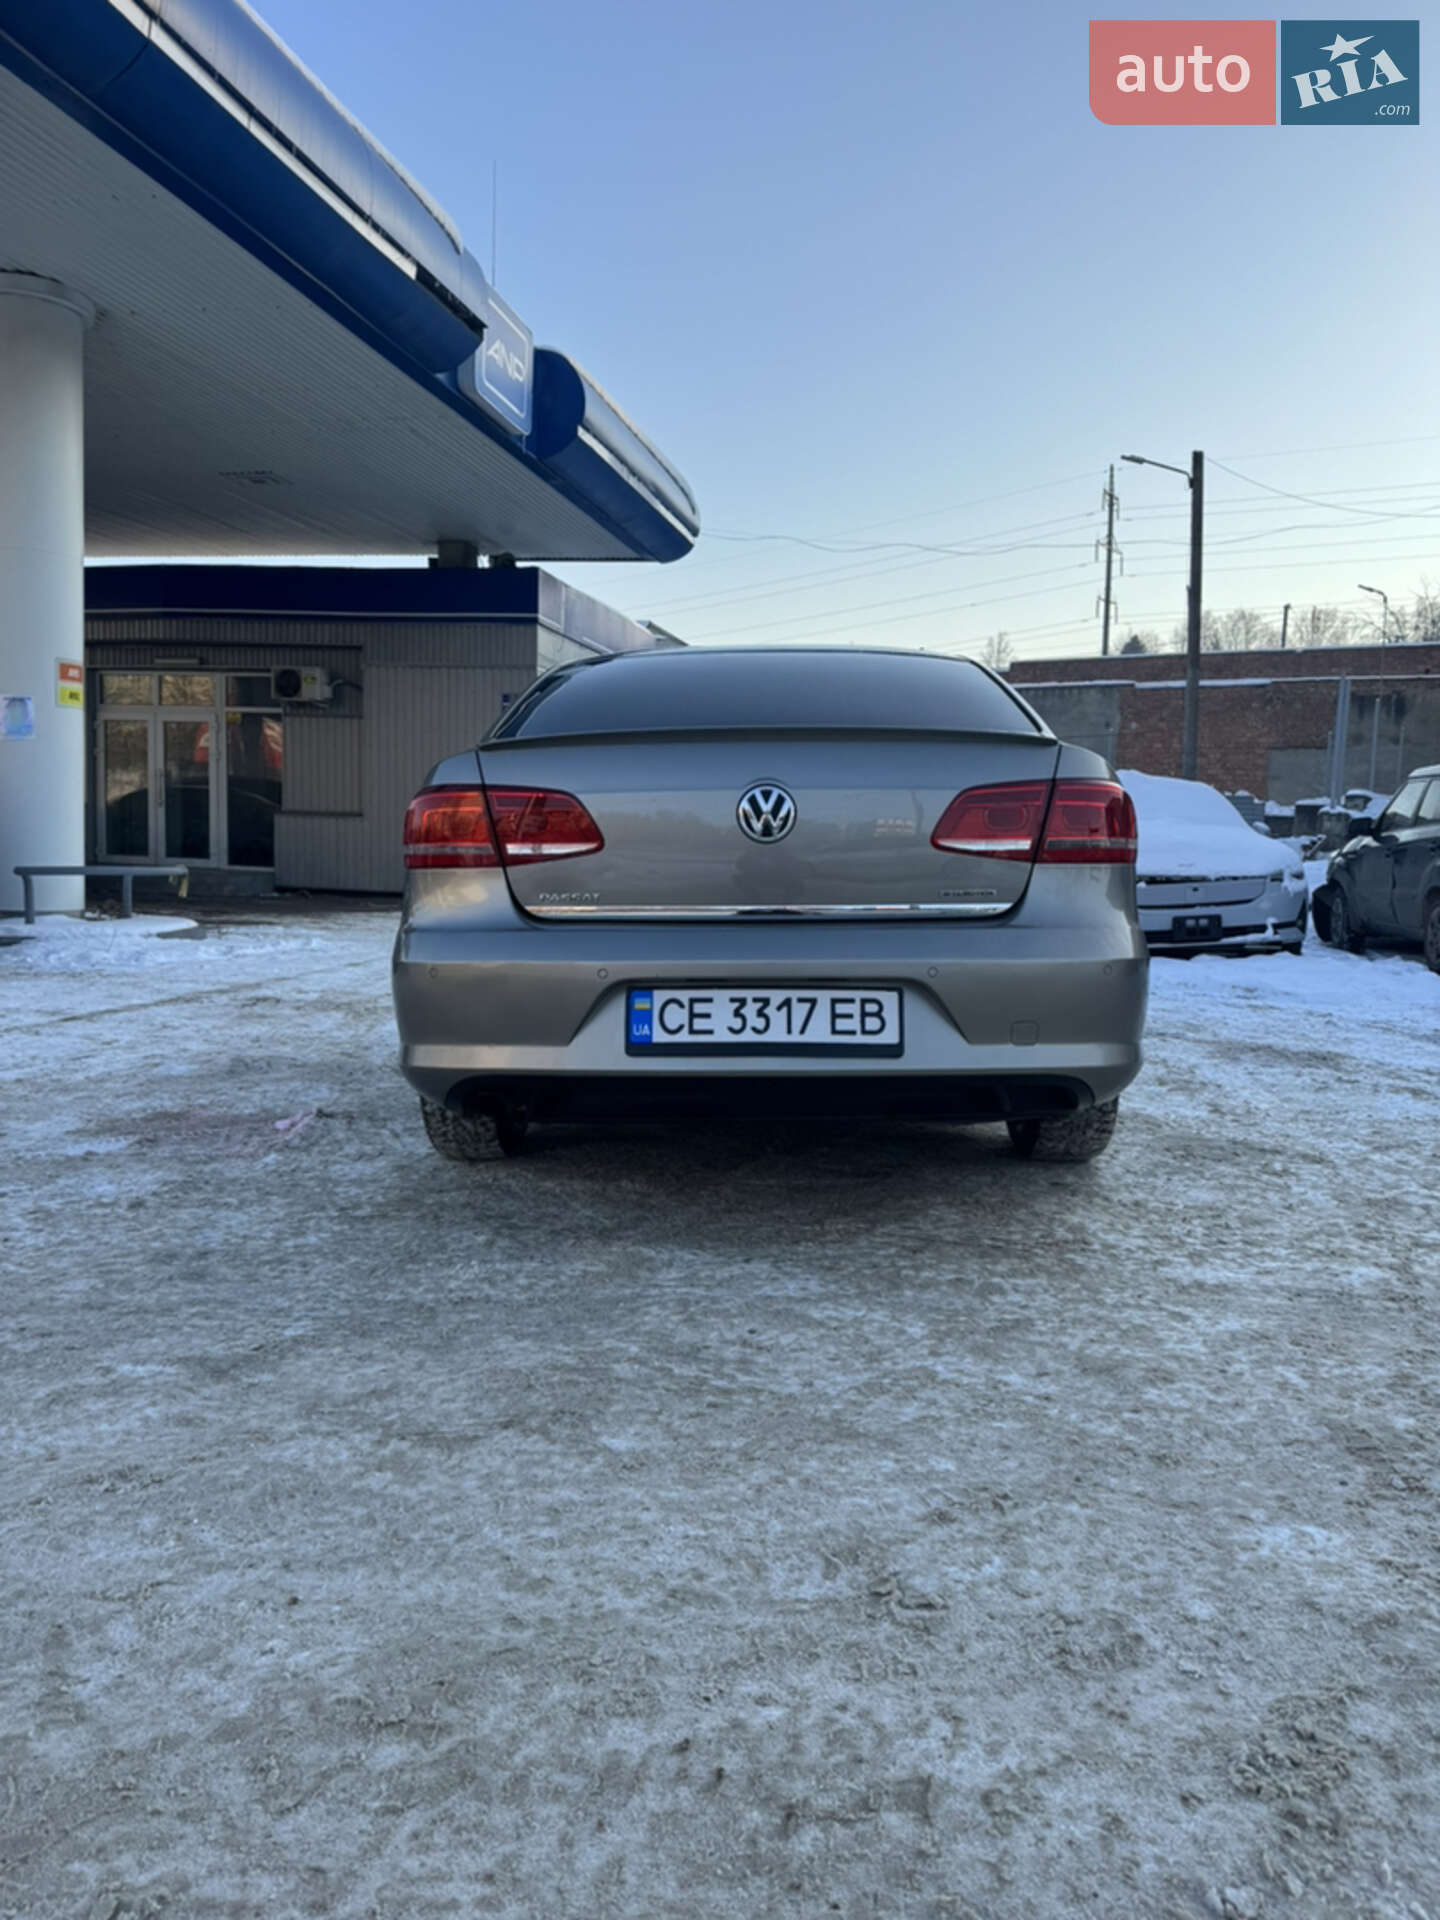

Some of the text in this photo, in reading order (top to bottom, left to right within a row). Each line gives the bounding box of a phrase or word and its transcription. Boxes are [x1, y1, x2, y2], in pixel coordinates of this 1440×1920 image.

[658, 997, 887, 1036] CE 3317 EB
[633, 1024, 650, 1036] UA
